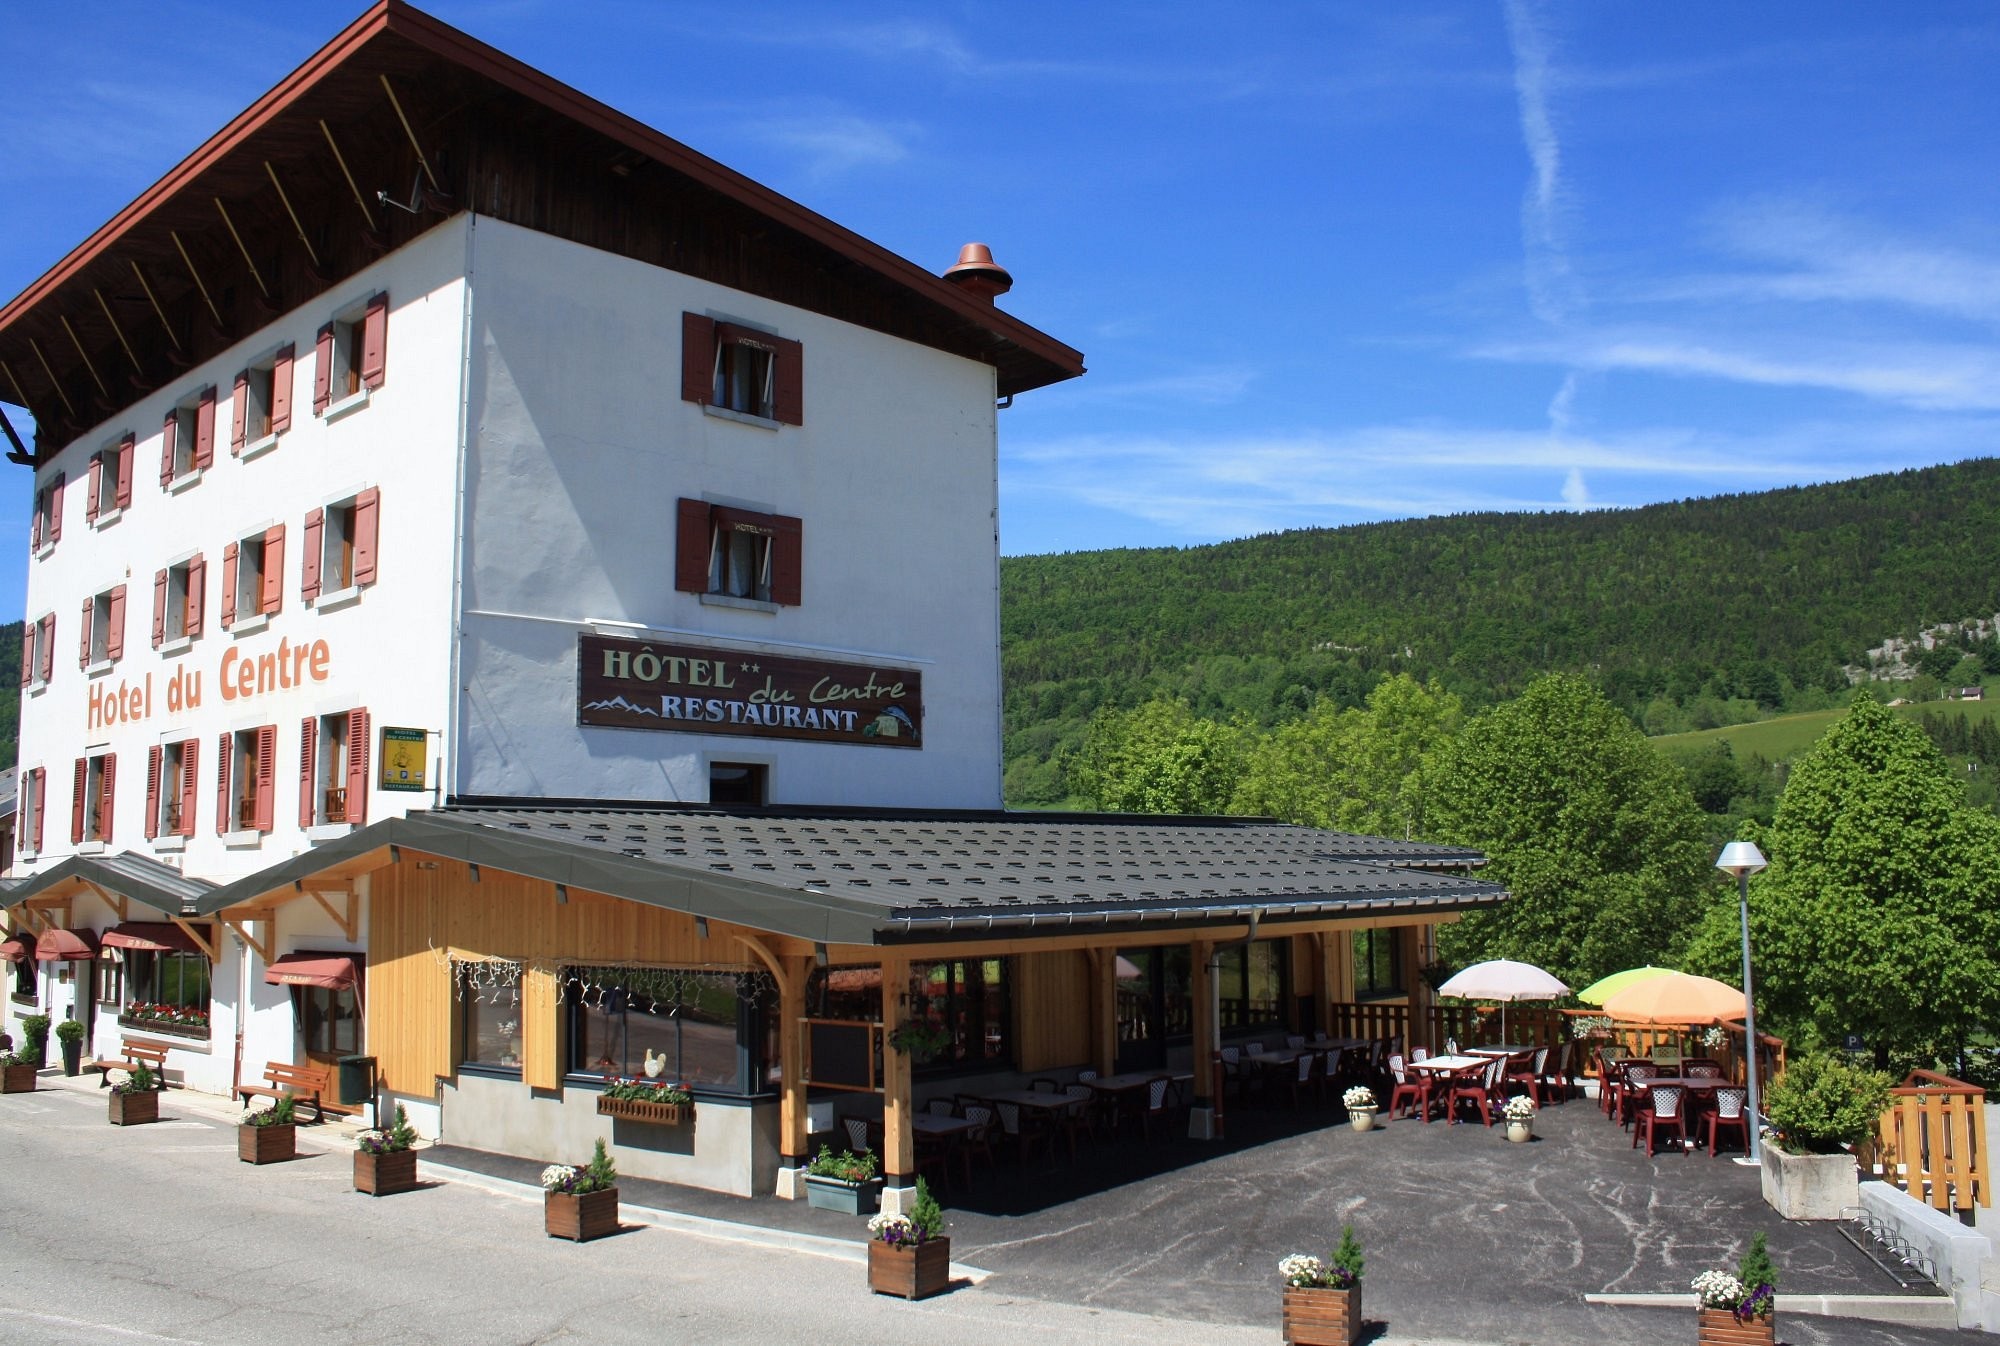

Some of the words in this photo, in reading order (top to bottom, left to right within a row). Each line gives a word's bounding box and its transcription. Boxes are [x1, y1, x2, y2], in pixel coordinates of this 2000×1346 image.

[735, 522, 760, 534] HOTEL
[88, 672, 152, 729] Hotel
[167, 664, 201, 712] du
[220, 636, 330, 701] Centre
[602, 646, 735, 689] HÔTEL
[749, 675, 795, 704] du
[809, 671, 906, 703] Centre
[661, 695, 858, 732] RESTAURANT
[1849, 1035, 1857, 1046] P
